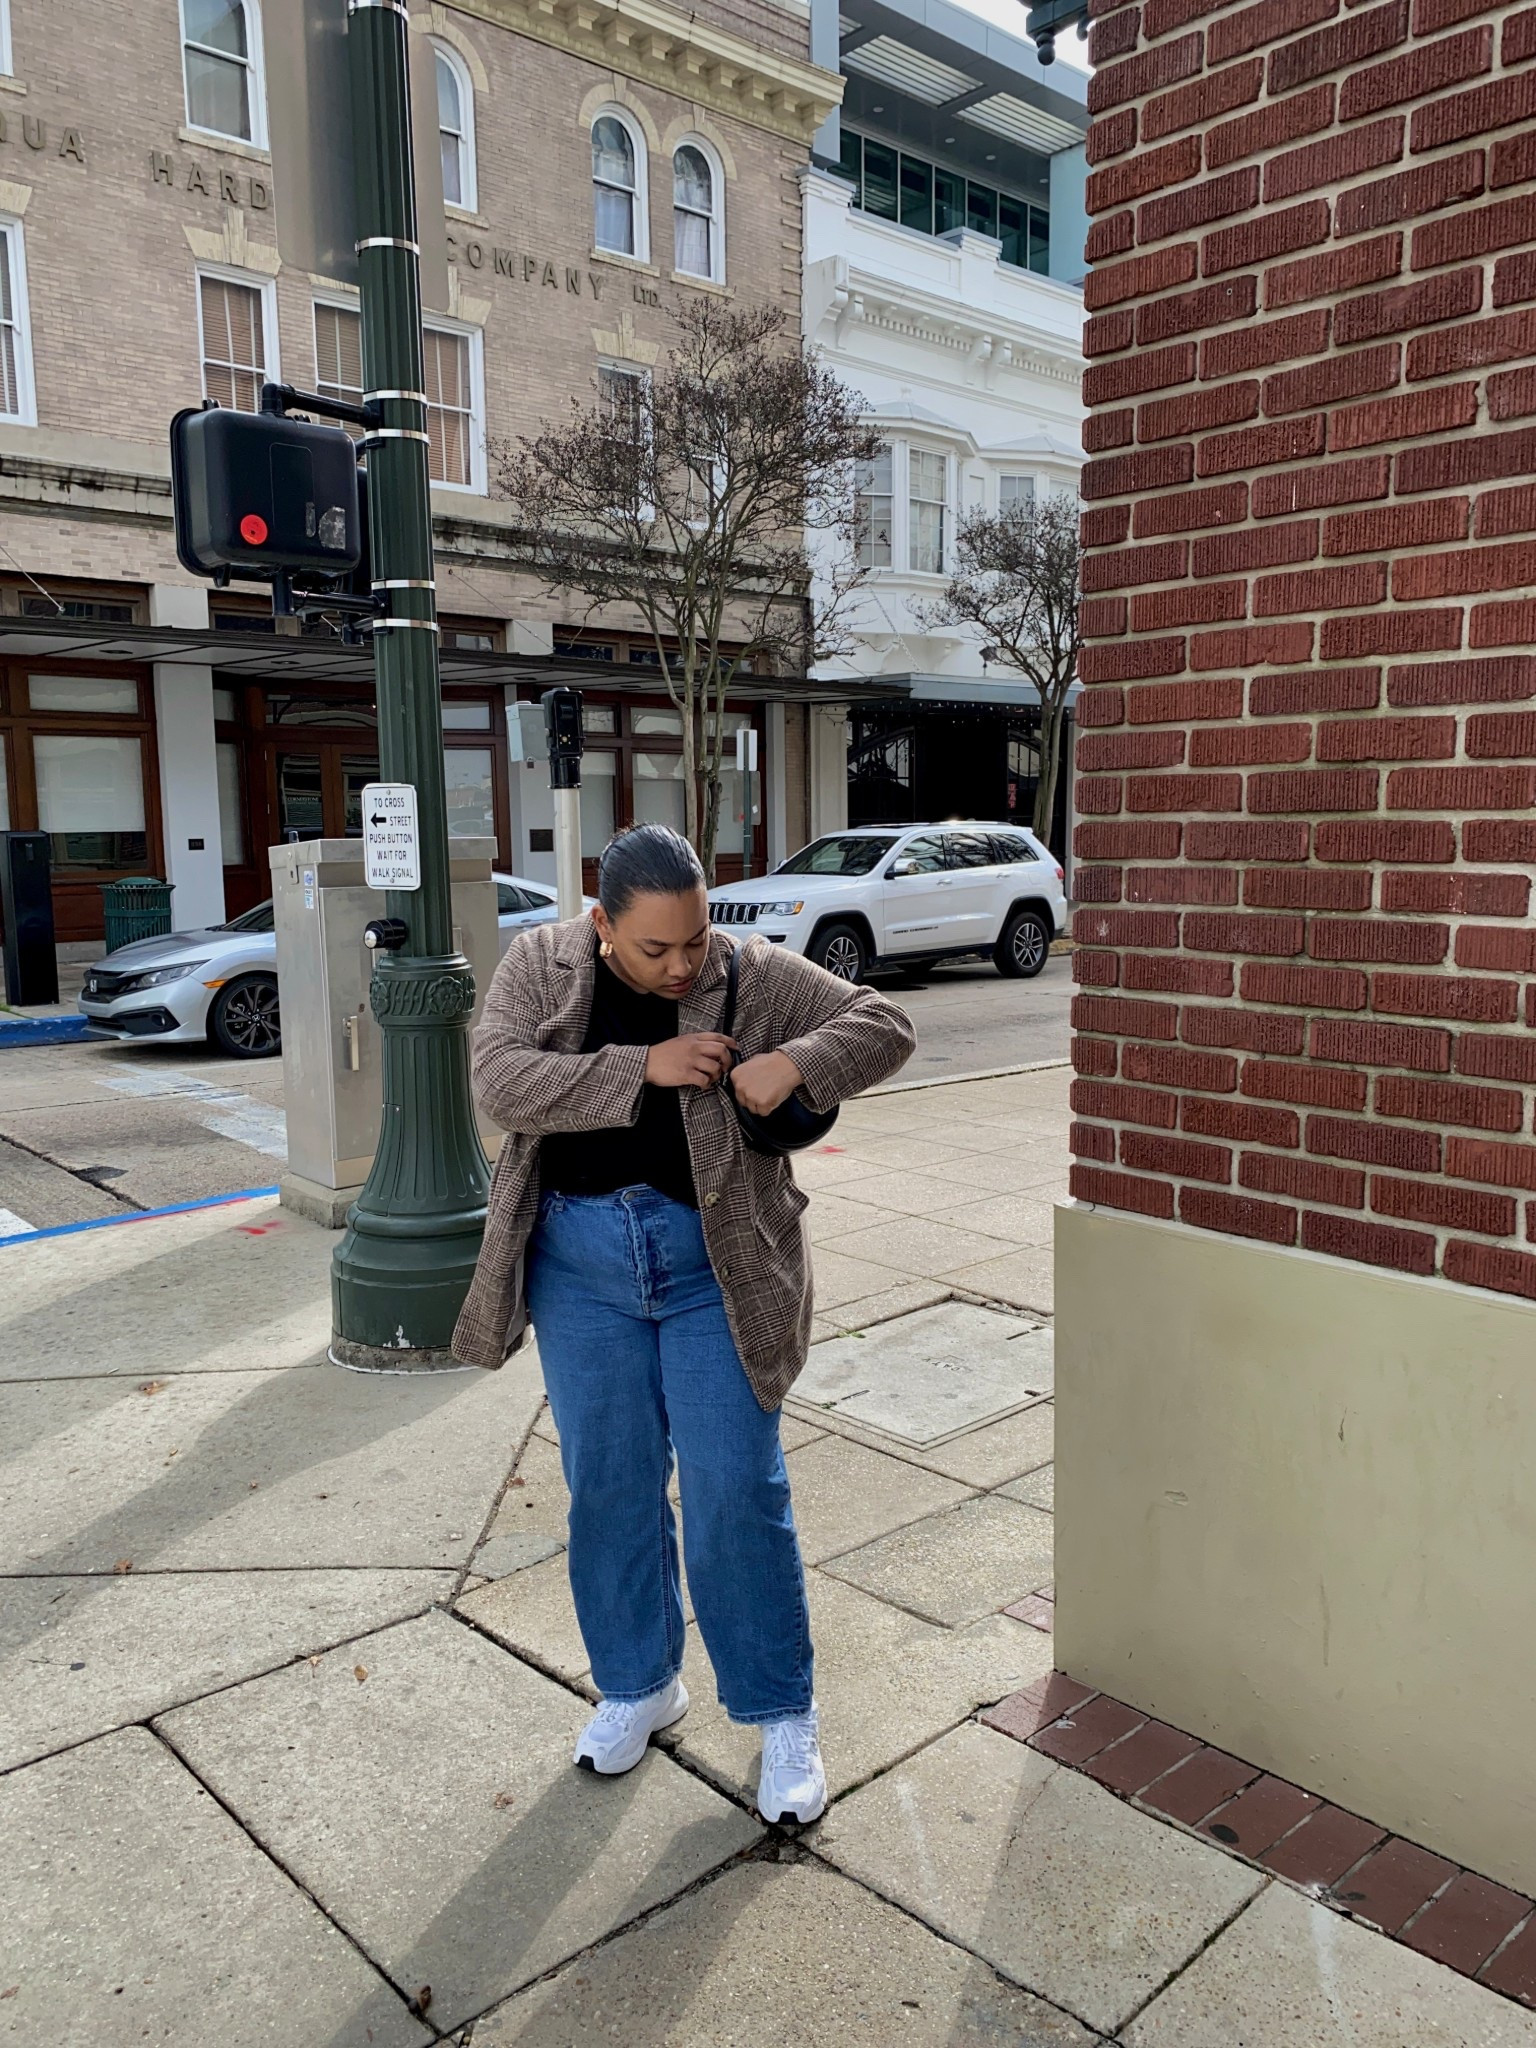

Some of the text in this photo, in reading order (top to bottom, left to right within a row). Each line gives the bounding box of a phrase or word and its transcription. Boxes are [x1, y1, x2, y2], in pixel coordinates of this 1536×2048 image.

[0, 110, 84, 163] UA
[152, 150, 270, 210] HARD
[446, 237, 605, 300] COMPANY
[374, 798, 405, 808] TO CROSS
[390, 816, 411, 826] STREET
[370, 834, 412, 843] PUSH BUTTON
[377, 851, 407, 860] WAIT FOR
[372, 868, 413, 878] WALK SIGNAL
